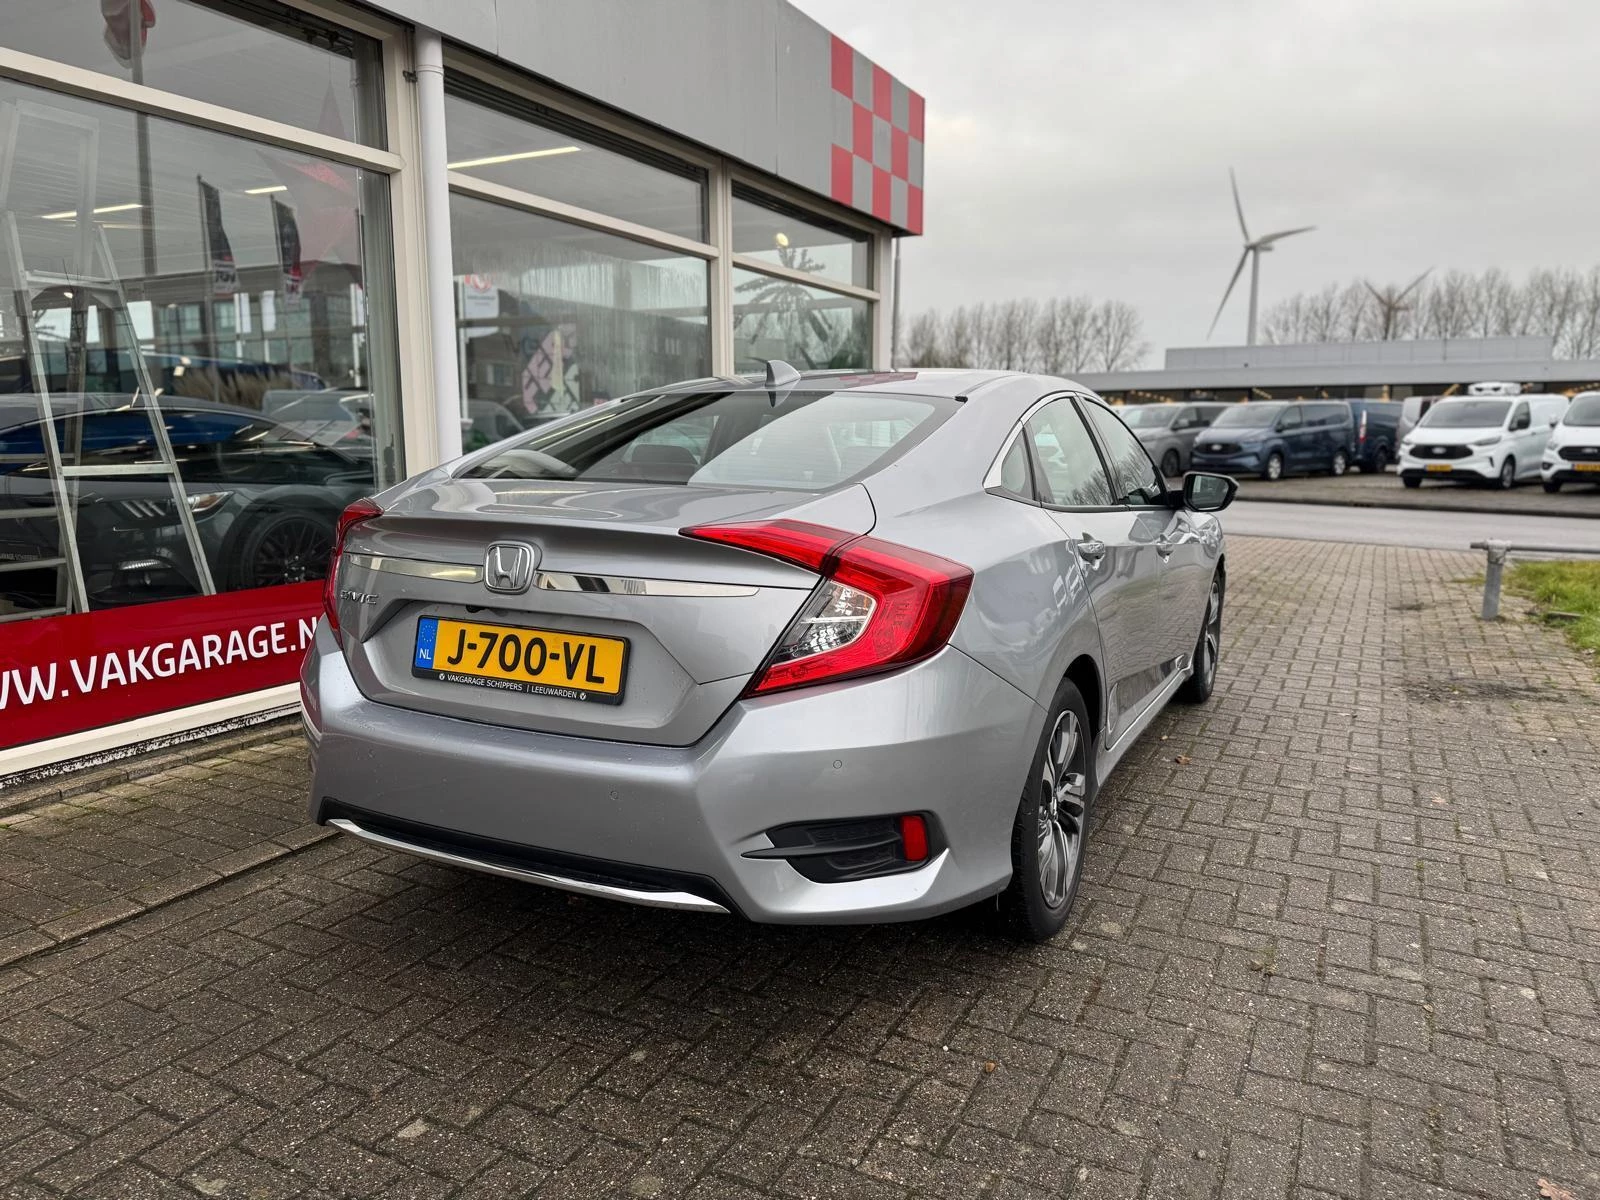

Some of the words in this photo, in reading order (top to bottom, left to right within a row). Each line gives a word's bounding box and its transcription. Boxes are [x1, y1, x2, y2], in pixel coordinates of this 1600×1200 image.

[0, 616, 317, 710] W.VAKGARAGE.N
[419, 647, 432, 660] NL
[447, 628, 605, 684] J-700-VL
[447, 674, 485, 686] VAKGARAGE
[486, 680, 523, 691] SCHIPPERS
[531, 685, 577, 699] LEEUWARDEN
